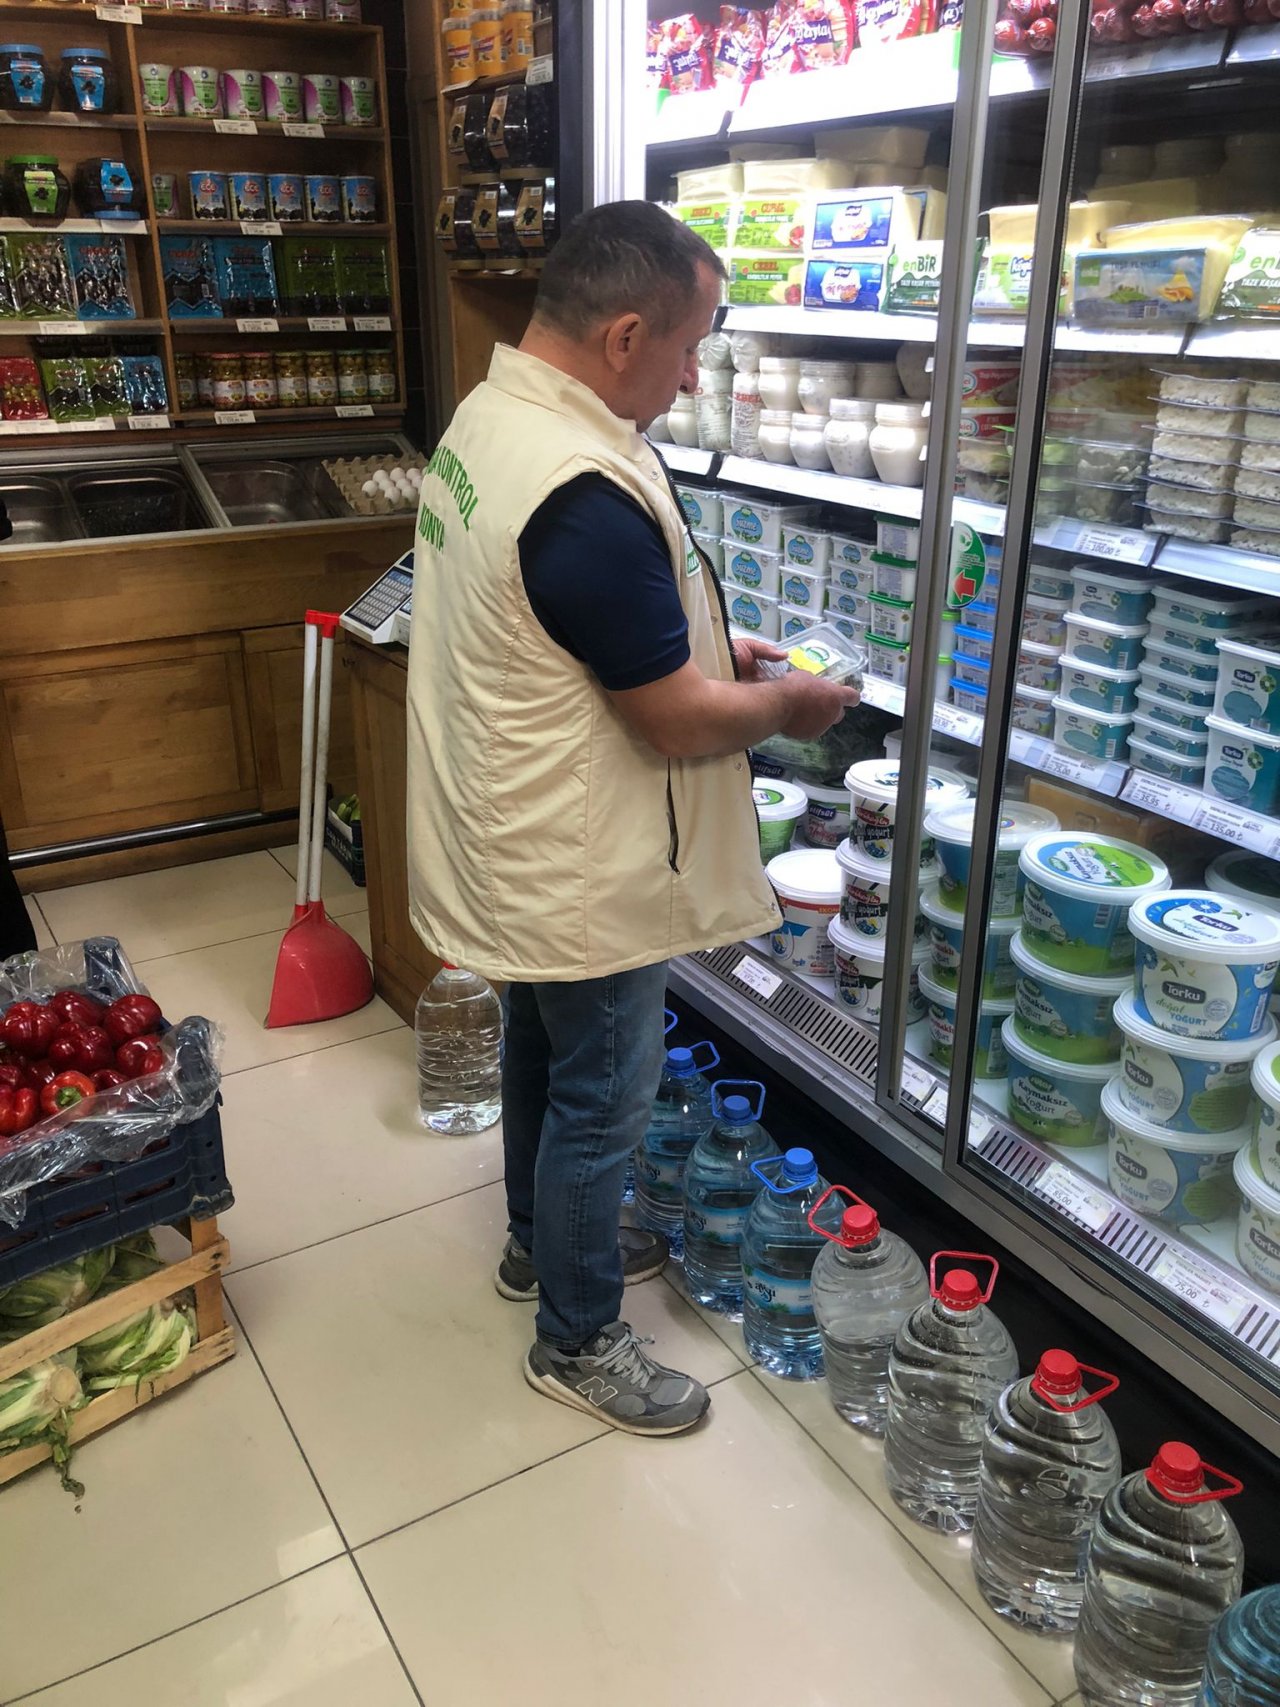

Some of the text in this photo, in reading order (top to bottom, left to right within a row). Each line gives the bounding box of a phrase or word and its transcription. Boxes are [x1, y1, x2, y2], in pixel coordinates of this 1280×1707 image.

[419, 502, 444, 551] KONYA
[1210, 823, 1236, 839] 135,00
[1166, 983, 1201, 1001] Torku
[1126, 1064, 1149, 1084] Torku
[1019, 1080, 1068, 1107] Kaymaksız
[1118, 1155, 1142, 1176] Torku
[1053, 1190, 1072, 1205] 85,00
[1175, 1281, 1197, 1299] 75,00
